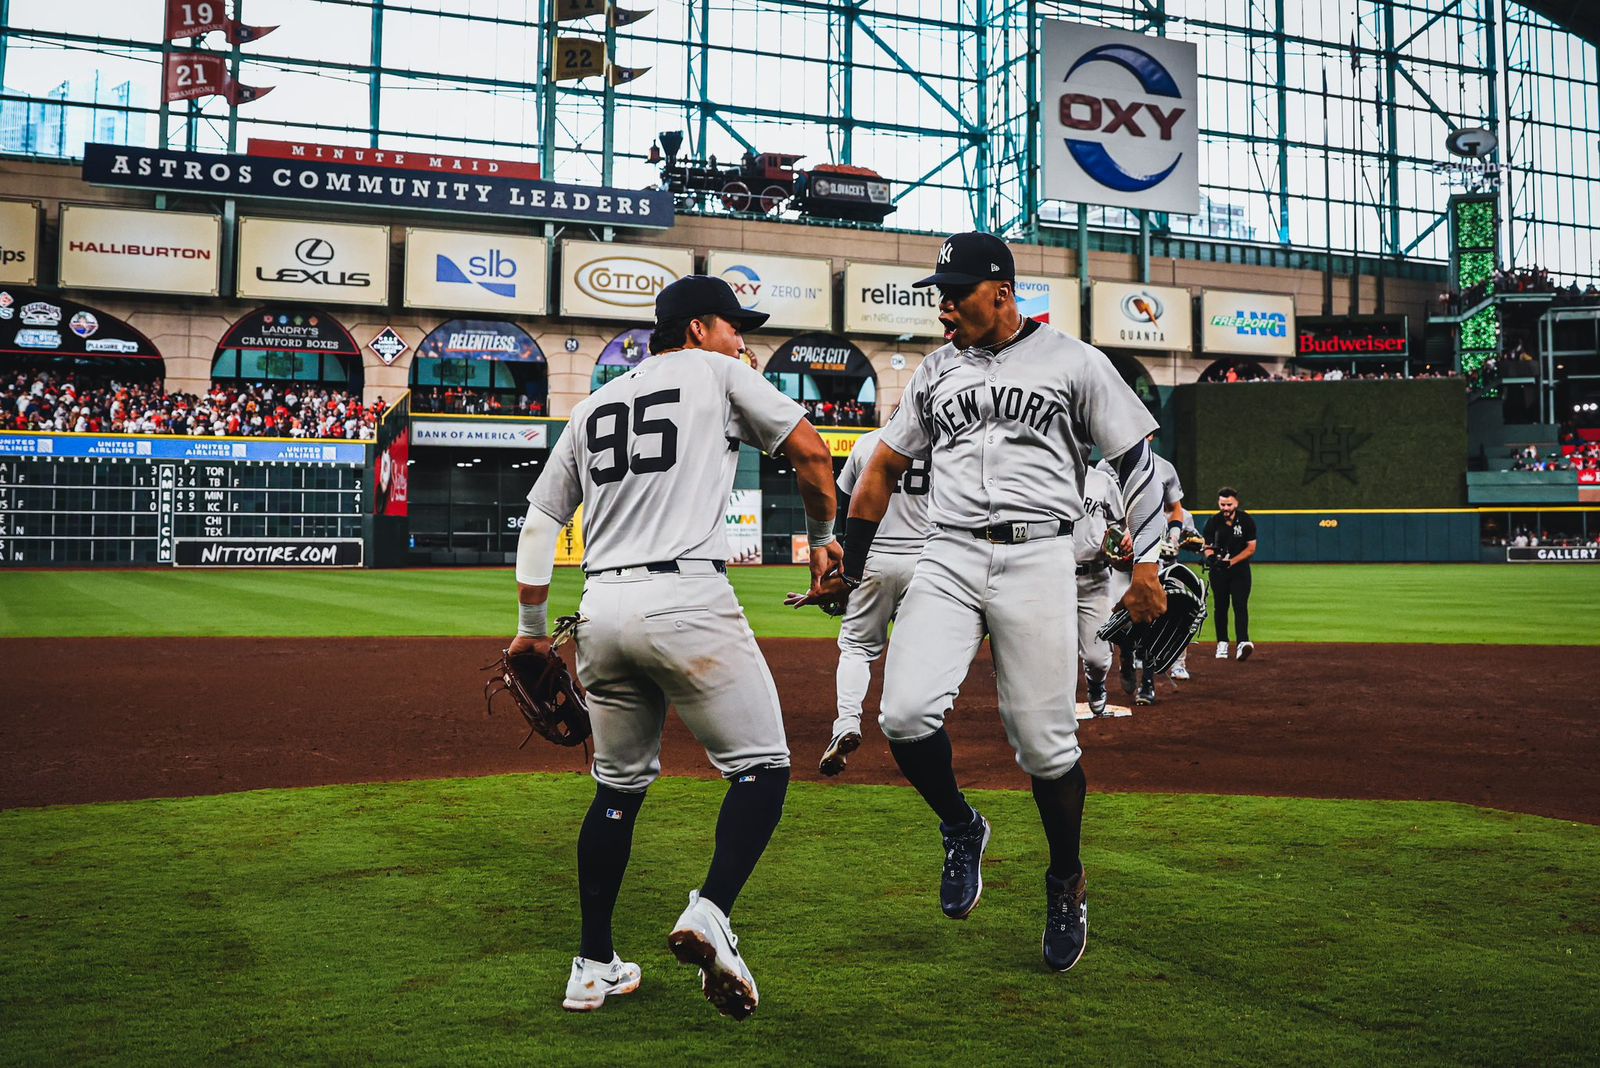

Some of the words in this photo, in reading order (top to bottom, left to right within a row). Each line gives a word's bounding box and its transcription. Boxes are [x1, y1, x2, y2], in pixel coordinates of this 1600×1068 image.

[182, 3, 213, 25] 19
[564, 49, 592, 68] 22
[176, 63, 207, 86] 21
[1059, 93, 1186, 140] OXY
[291, 145, 405, 165] MINUTE
[429, 157, 500, 173] MAID
[111, 155, 253, 184] ASTROS
[272, 168, 493, 202] COMMUNITY
[509, 187, 651, 216] LEADERS
[69, 241, 211, 260] HALLIBURTON
[469, 249, 517, 278] slb
[256, 266, 371, 287] LEXUS
[588, 267, 664, 296] COTTON
[730, 282, 762, 296] XY
[771, 285, 801, 298] ZERO
[861, 283, 936, 307] reliant
[1211, 315, 1277, 330] FREEPORT
[1236, 311, 1287, 337] LNG
[261, 325, 319, 336] LANDRY'S
[1120, 329, 1165, 342] QUANTA
[241, 336, 303, 347] CRAWFORD
[306, 340, 339, 349] BOXES
[448, 333, 516, 351] RELENTLESS
[1300, 335, 1406, 353] Budweiser
[791, 346, 825, 362] SPACE
[826, 348, 851, 364] CITY
[936, 390, 981, 437] NEW
[991, 386, 1061, 436] YORK
[417, 430, 447, 438] BANK
[451, 431, 463, 439] OF
[467, 432, 516, 440] AMERICA
[586, 388, 680, 487] 95
[152, 466, 157, 475] 3
[205, 467, 224, 476] TOR
[893, 457, 930, 495] 8
[19, 475, 25, 483] F
[209, 478, 220, 487] TB
[234, 479, 239, 487] F
[355, 480, 361, 489] 2
[151, 491, 155, 500] 1
[204, 492, 224, 500] MIN
[354, 493, 360, 502] 4
[18, 500, 24, 509] F
[207, 503, 220, 512] KC
[233, 503, 239, 512] F
[355, 504, 359, 513] 1
[161, 468, 172, 559] AMERICAN
[726, 514, 758, 524] WM
[205, 516, 222, 525] CHI
[1319, 519, 1338, 528] 409
[16, 526, 25, 535] N
[204, 527, 222, 536] TEX
[1015, 526, 1026, 539] 22
[15, 552, 24, 560] N
[201, 545, 337, 564] NITTOTIRE.COM
[1537, 549, 1597, 559] GALLERY
